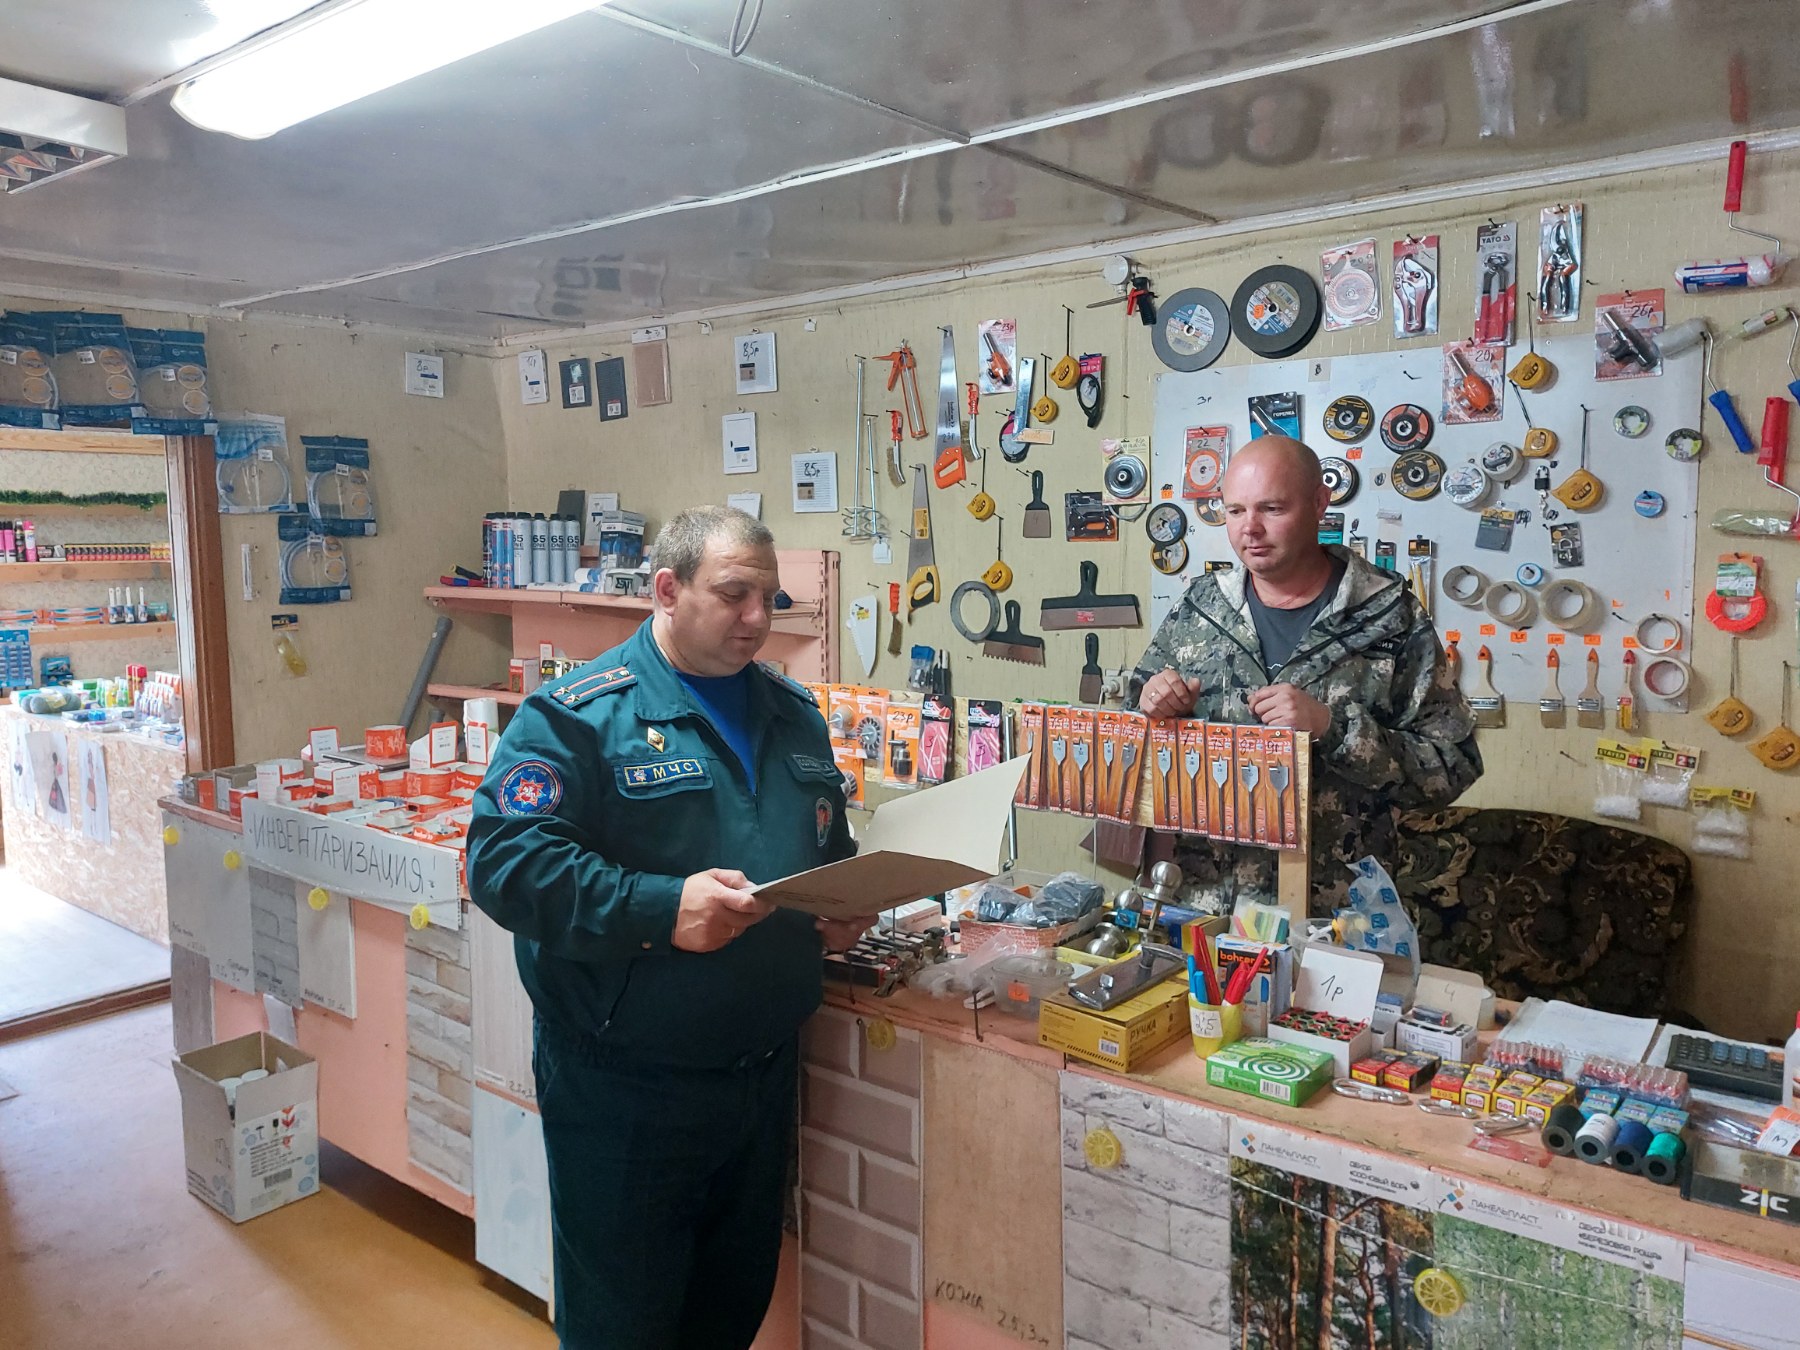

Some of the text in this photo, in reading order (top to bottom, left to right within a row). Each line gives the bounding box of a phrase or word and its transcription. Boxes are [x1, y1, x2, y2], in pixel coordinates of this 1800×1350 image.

[1482, 235, 1502, 244] YATO
[532, 535, 546, 543] 65
[551, 535, 564, 544] 65
[567, 535, 580, 544] 65
[1678, 756, 1687, 766] 2
[652, 762, 695, 780] МЧС
[1129, 1018, 1157, 1043] РУЧКА
[1740, 1188, 1790, 1217] ZIC
[1470, 1199, 1541, 1225] ПАНЕЛЬПЛАСТ
